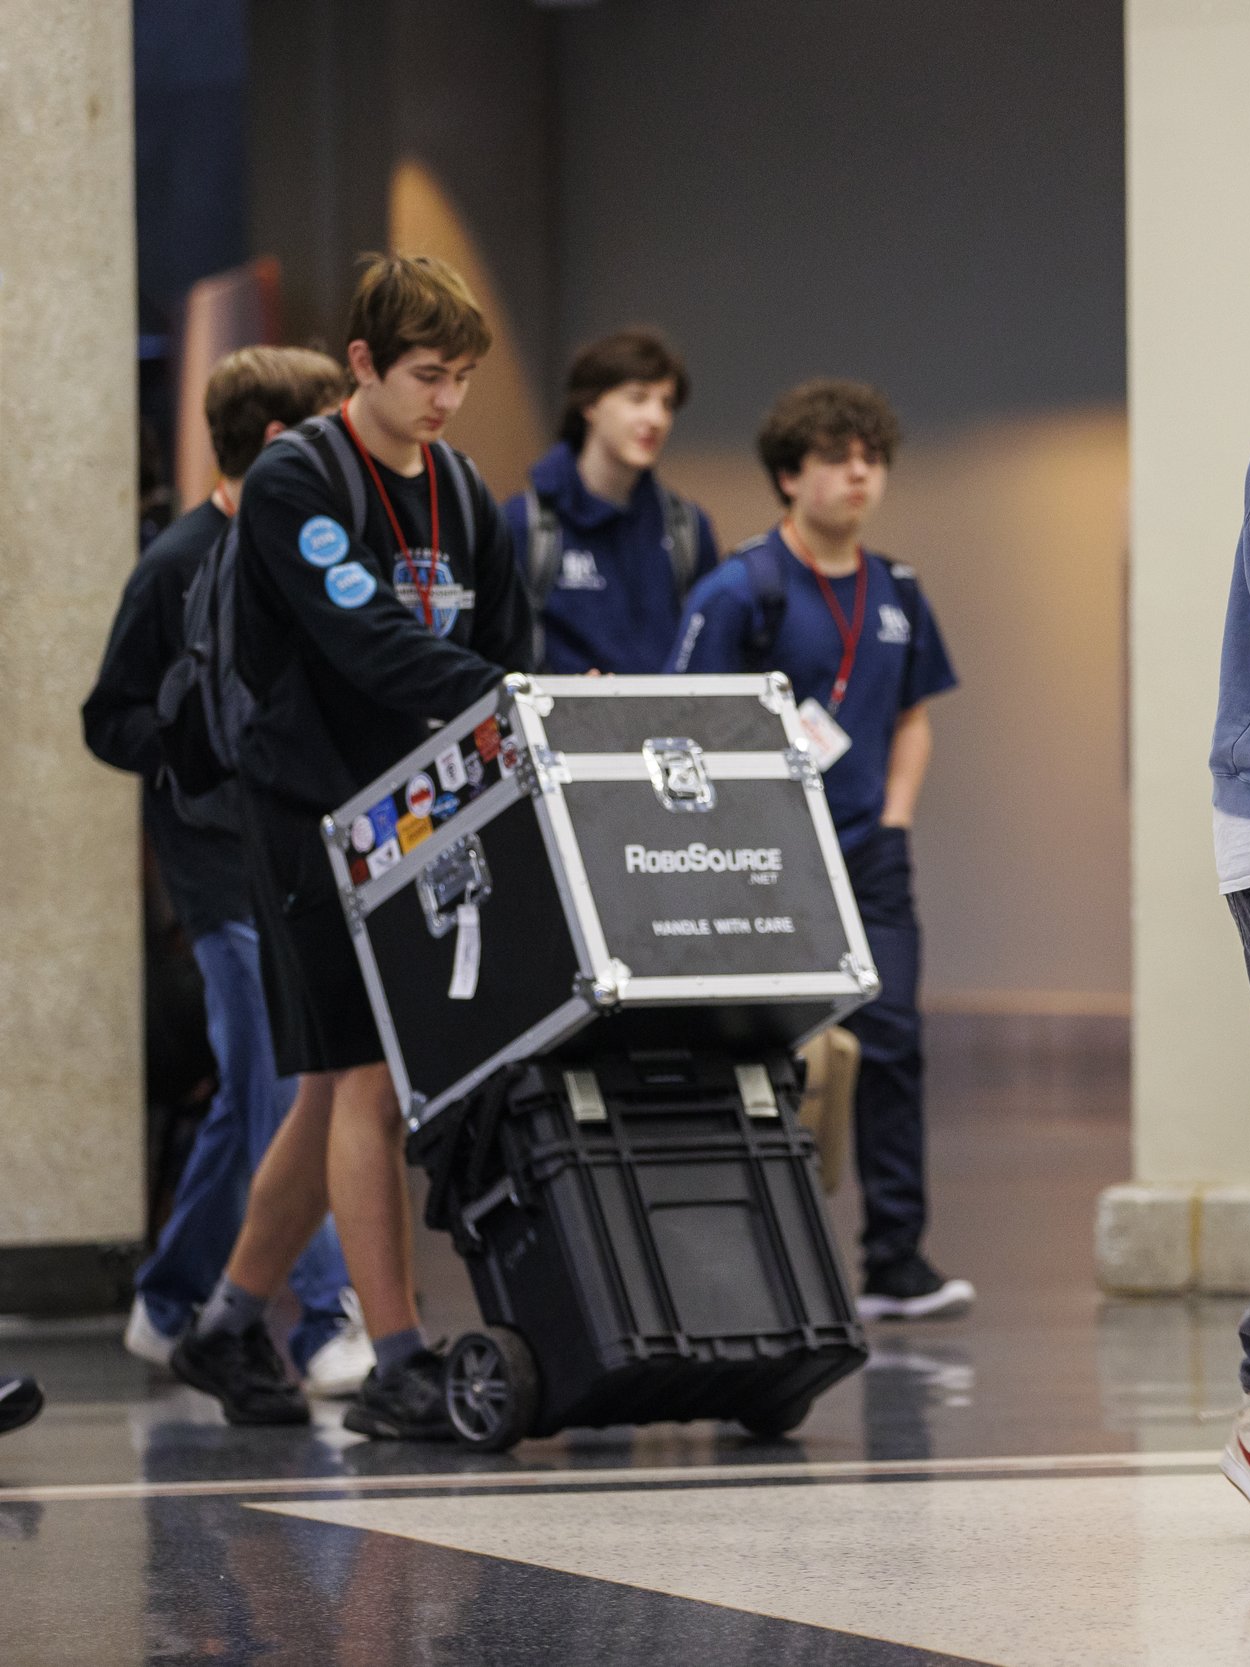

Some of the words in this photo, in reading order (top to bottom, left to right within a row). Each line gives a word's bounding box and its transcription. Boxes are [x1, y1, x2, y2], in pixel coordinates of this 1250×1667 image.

[651, 919, 712, 936] HANDLE
[713, 918, 751, 934] WITH
[754, 917, 795, 933] CARE
